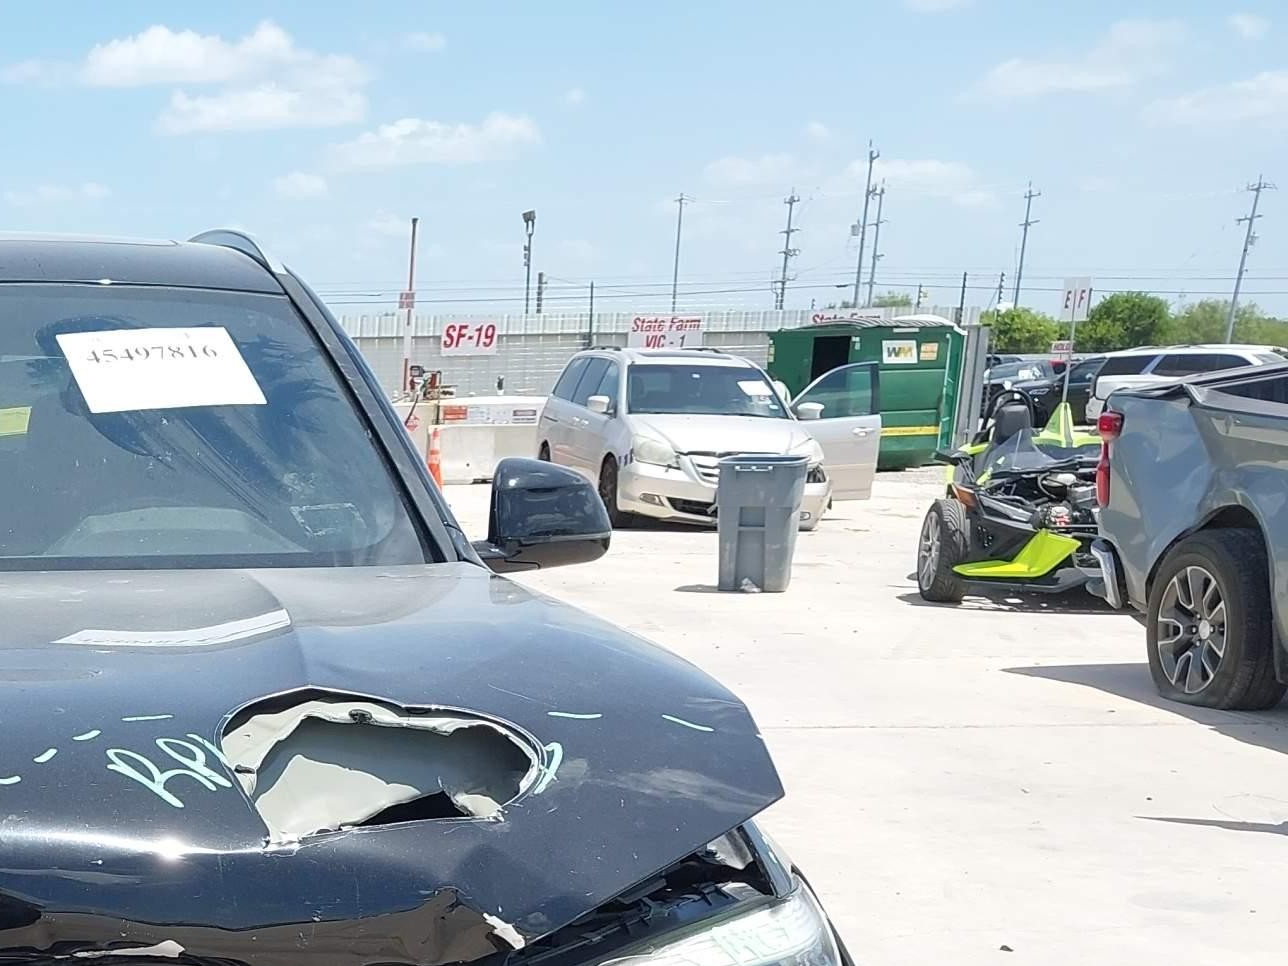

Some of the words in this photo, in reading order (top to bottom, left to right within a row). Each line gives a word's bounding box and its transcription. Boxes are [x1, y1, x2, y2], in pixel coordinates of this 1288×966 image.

[632, 316, 665, 332] State
[669, 317, 701, 331] Farm
[443, 324, 496, 348] SF-19
[86, 344, 218, 364] 45497816
[887, 346, 913, 358] WM
